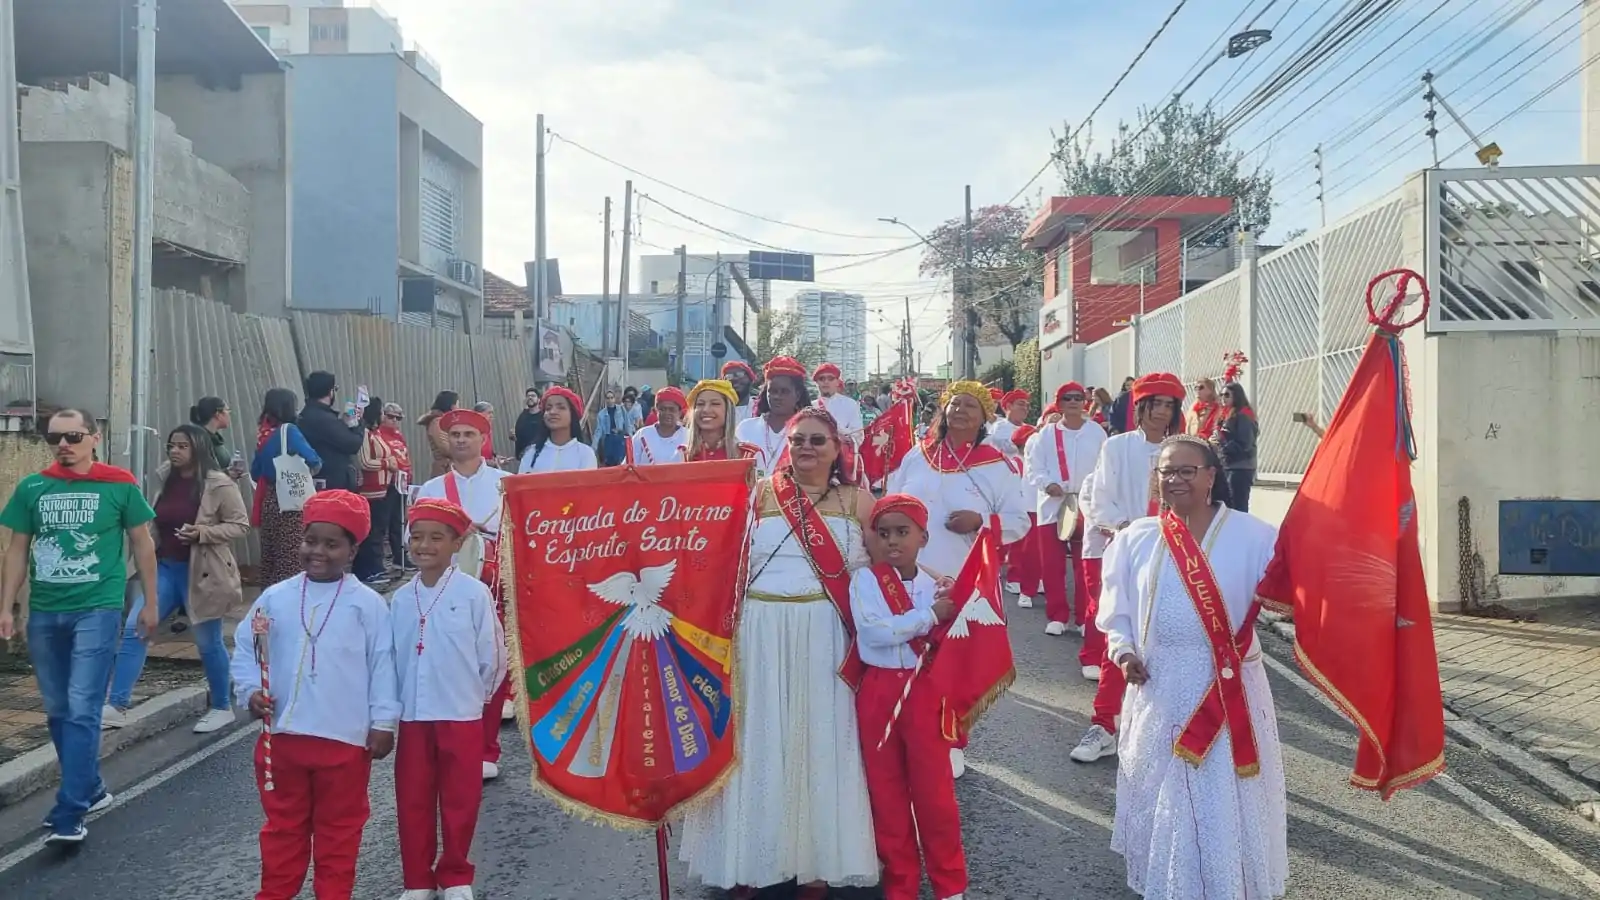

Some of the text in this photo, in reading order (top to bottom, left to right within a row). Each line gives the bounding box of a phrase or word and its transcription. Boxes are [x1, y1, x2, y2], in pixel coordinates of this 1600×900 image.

[39, 499, 99, 511] ENTRADA DOS
[41, 509, 95, 524] PALMITOS
[525, 496, 733, 544] Congada do Divino
[640, 526, 709, 552] Santo
[678, 722, 699, 758] Deus
